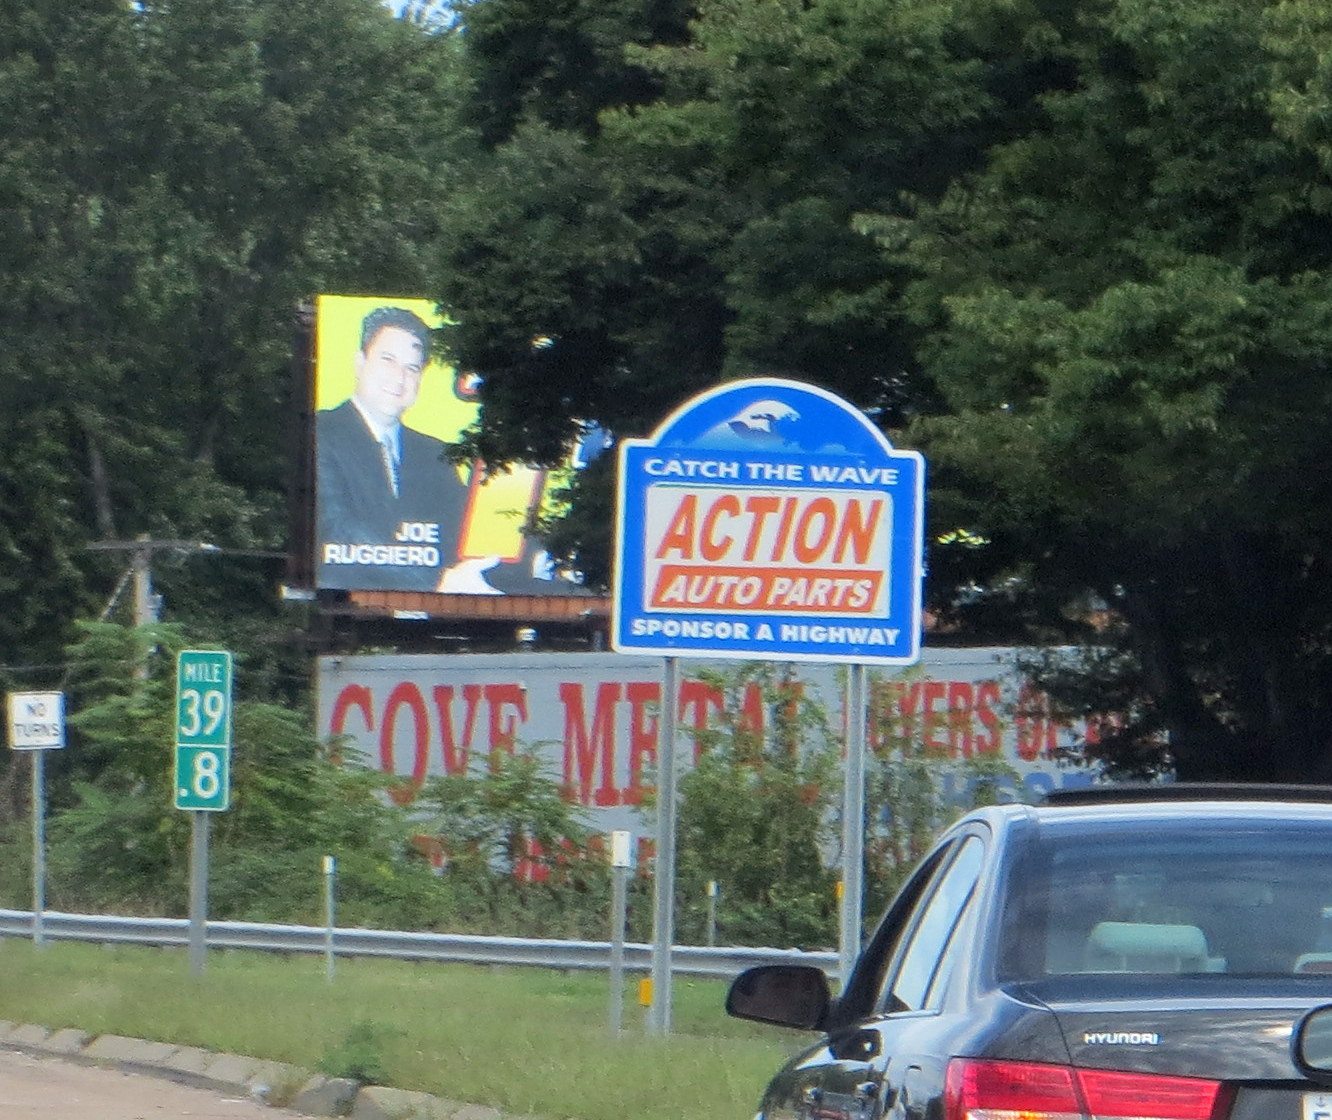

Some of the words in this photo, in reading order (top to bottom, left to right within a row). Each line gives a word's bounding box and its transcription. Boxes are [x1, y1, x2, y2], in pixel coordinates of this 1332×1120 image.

[643, 458, 739, 479] CATCH
[746, 462, 803, 481] THE
[809, 465, 900, 485] WAVE
[395, 521, 440, 542] JOE
[655, 494, 884, 564] ACTION
[324, 544, 440, 567] RUGGIERO
[661, 574, 762, 605] AUTO
[766, 576, 873, 608] PARTS
[631, 618, 750, 641] SPONSOR
[755, 622, 774, 641] A
[781, 624, 901, 646] HIGHWAY
[184, 662, 223, 683] MILE
[27, 702, 48, 717] NO
[180, 689, 225, 737] 39
[14, 723, 60, 738] TURNS
[1083, 1031, 1160, 1045] HYUNDAI
